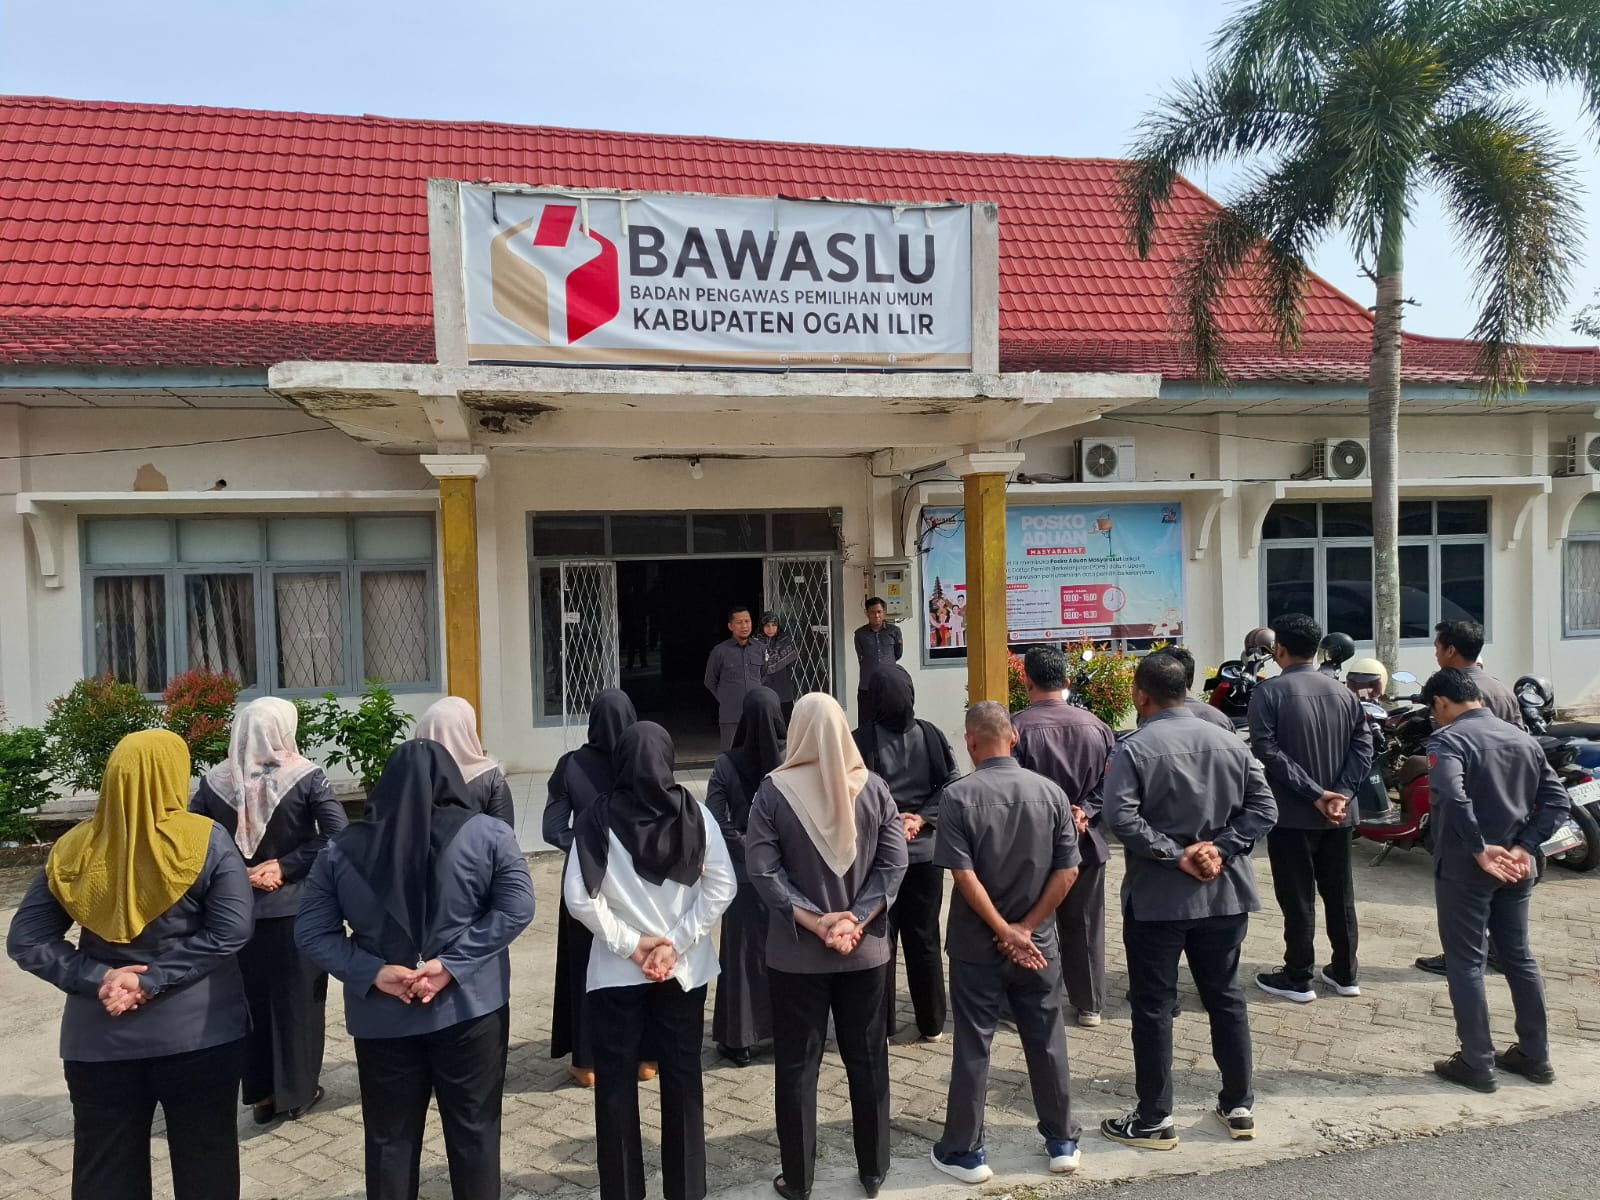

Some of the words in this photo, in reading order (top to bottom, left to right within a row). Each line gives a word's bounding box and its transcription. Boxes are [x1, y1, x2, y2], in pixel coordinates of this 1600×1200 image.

[628, 224, 936, 285] BAWASLU
[630, 285, 690, 301] BADAN
[696, 287, 790, 304] PENGAWAS
[795, 290, 881, 306] PEMILIHAN
[886, 292, 933, 306] UMUM
[633, 308, 794, 334] KABUPATEN
[803, 311, 879, 335] OGAN
[888, 313, 934, 335] ILIR
[1021, 513, 1086, 530] POSKO
[1023, 530, 1087, 546] ADUAN
[1030, 547, 1083, 556] MASYARAKAT
